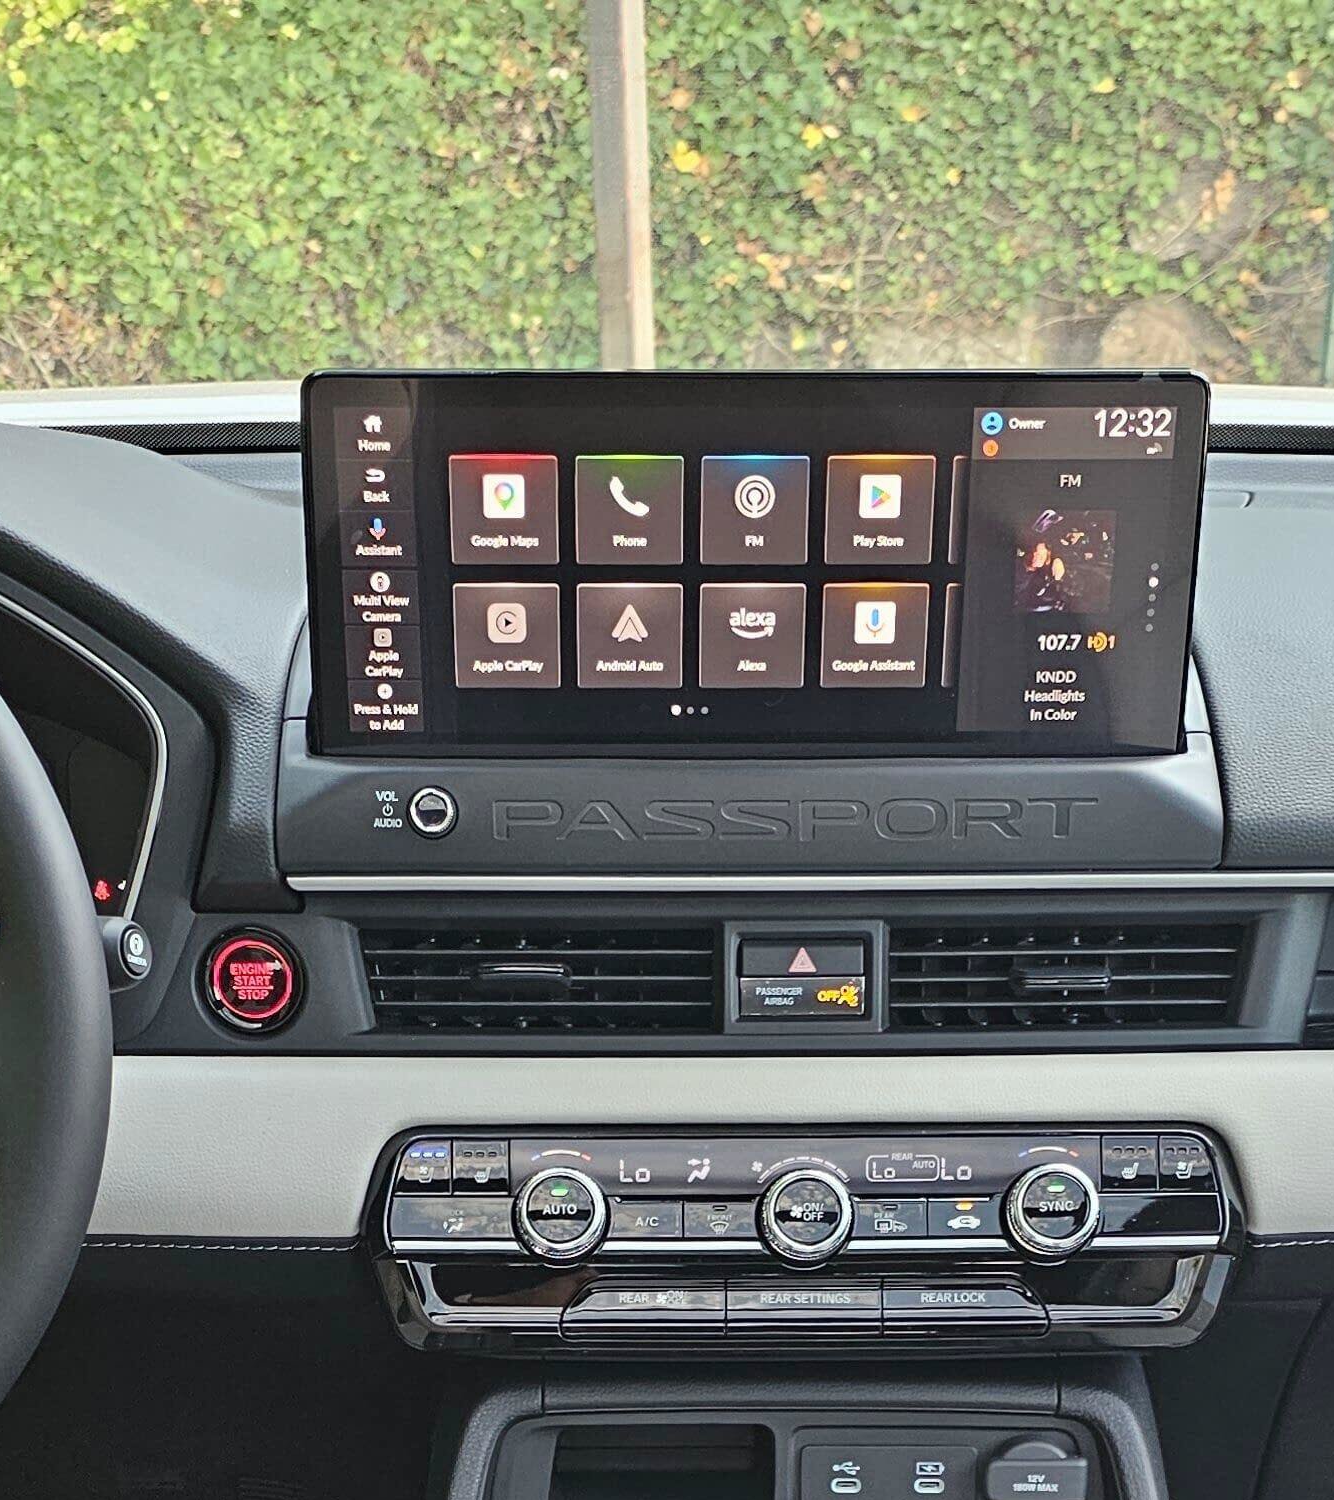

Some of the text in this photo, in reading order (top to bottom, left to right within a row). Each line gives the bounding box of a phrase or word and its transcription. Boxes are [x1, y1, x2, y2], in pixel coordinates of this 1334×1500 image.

[1008, 417, 1047, 430] Owner
[1094, 408, 1172, 438] 12:32
[357, 440, 391, 452] Home
[1059, 474, 1082, 488] FM
[363, 491, 390, 503] Back
[470, 535, 540, 549] Google Maps
[612, 535, 647, 548] Phone
[744, 535, 764, 547] FM
[853, 535, 904, 549] Play Store
[355, 544, 402, 557] Assistant
[353, 594, 410, 607] Multi View
[362, 611, 402, 623] Camera
[728, 607, 776, 627] alexa
[1037, 634, 1082, 651] 107.7
[368, 650, 399, 663] Apple
[365, 665, 403, 679] CarPlay
[472, 660, 544, 674] Apple CarPlay
[596, 660, 664, 672] Android Auto
[737, 660, 767, 672] Alexa
[832, 660, 916, 674] Google Assistant
[1035, 671, 1077, 684] KNDD
[1024, 689, 1086, 704] Headlights
[354, 703, 418, 716] Press & Hold
[1030, 708, 1077, 721] In Color
[369, 719, 404, 731] to Add
[375, 791, 398, 801] VOL
[373, 818, 402, 828] AUDIO
[492, 796, 1098, 842] PASSPORT
[230, 962, 274, 975] ENGINE
[234, 976, 272, 986] START
[237, 989, 269, 1000] STOP
[755, 987, 804, 996] PASSENGER
[763, 996, 795, 1006] AIRBAG
[891, 1153, 914, 1161] REAR
[912, 1160, 936, 1169] AUTO
[542, 1204, 578, 1216] AUTO
[1039, 1201, 1074, 1213] SYNC
[635, 1216, 660, 1228] A/C
[803, 1212, 824, 1222] OFF
[619, 1293, 648, 1304] REAR
[760, 1293, 851, 1304] REAR SETTINGS
[921, 1293, 986, 1303] REAR LOCK
